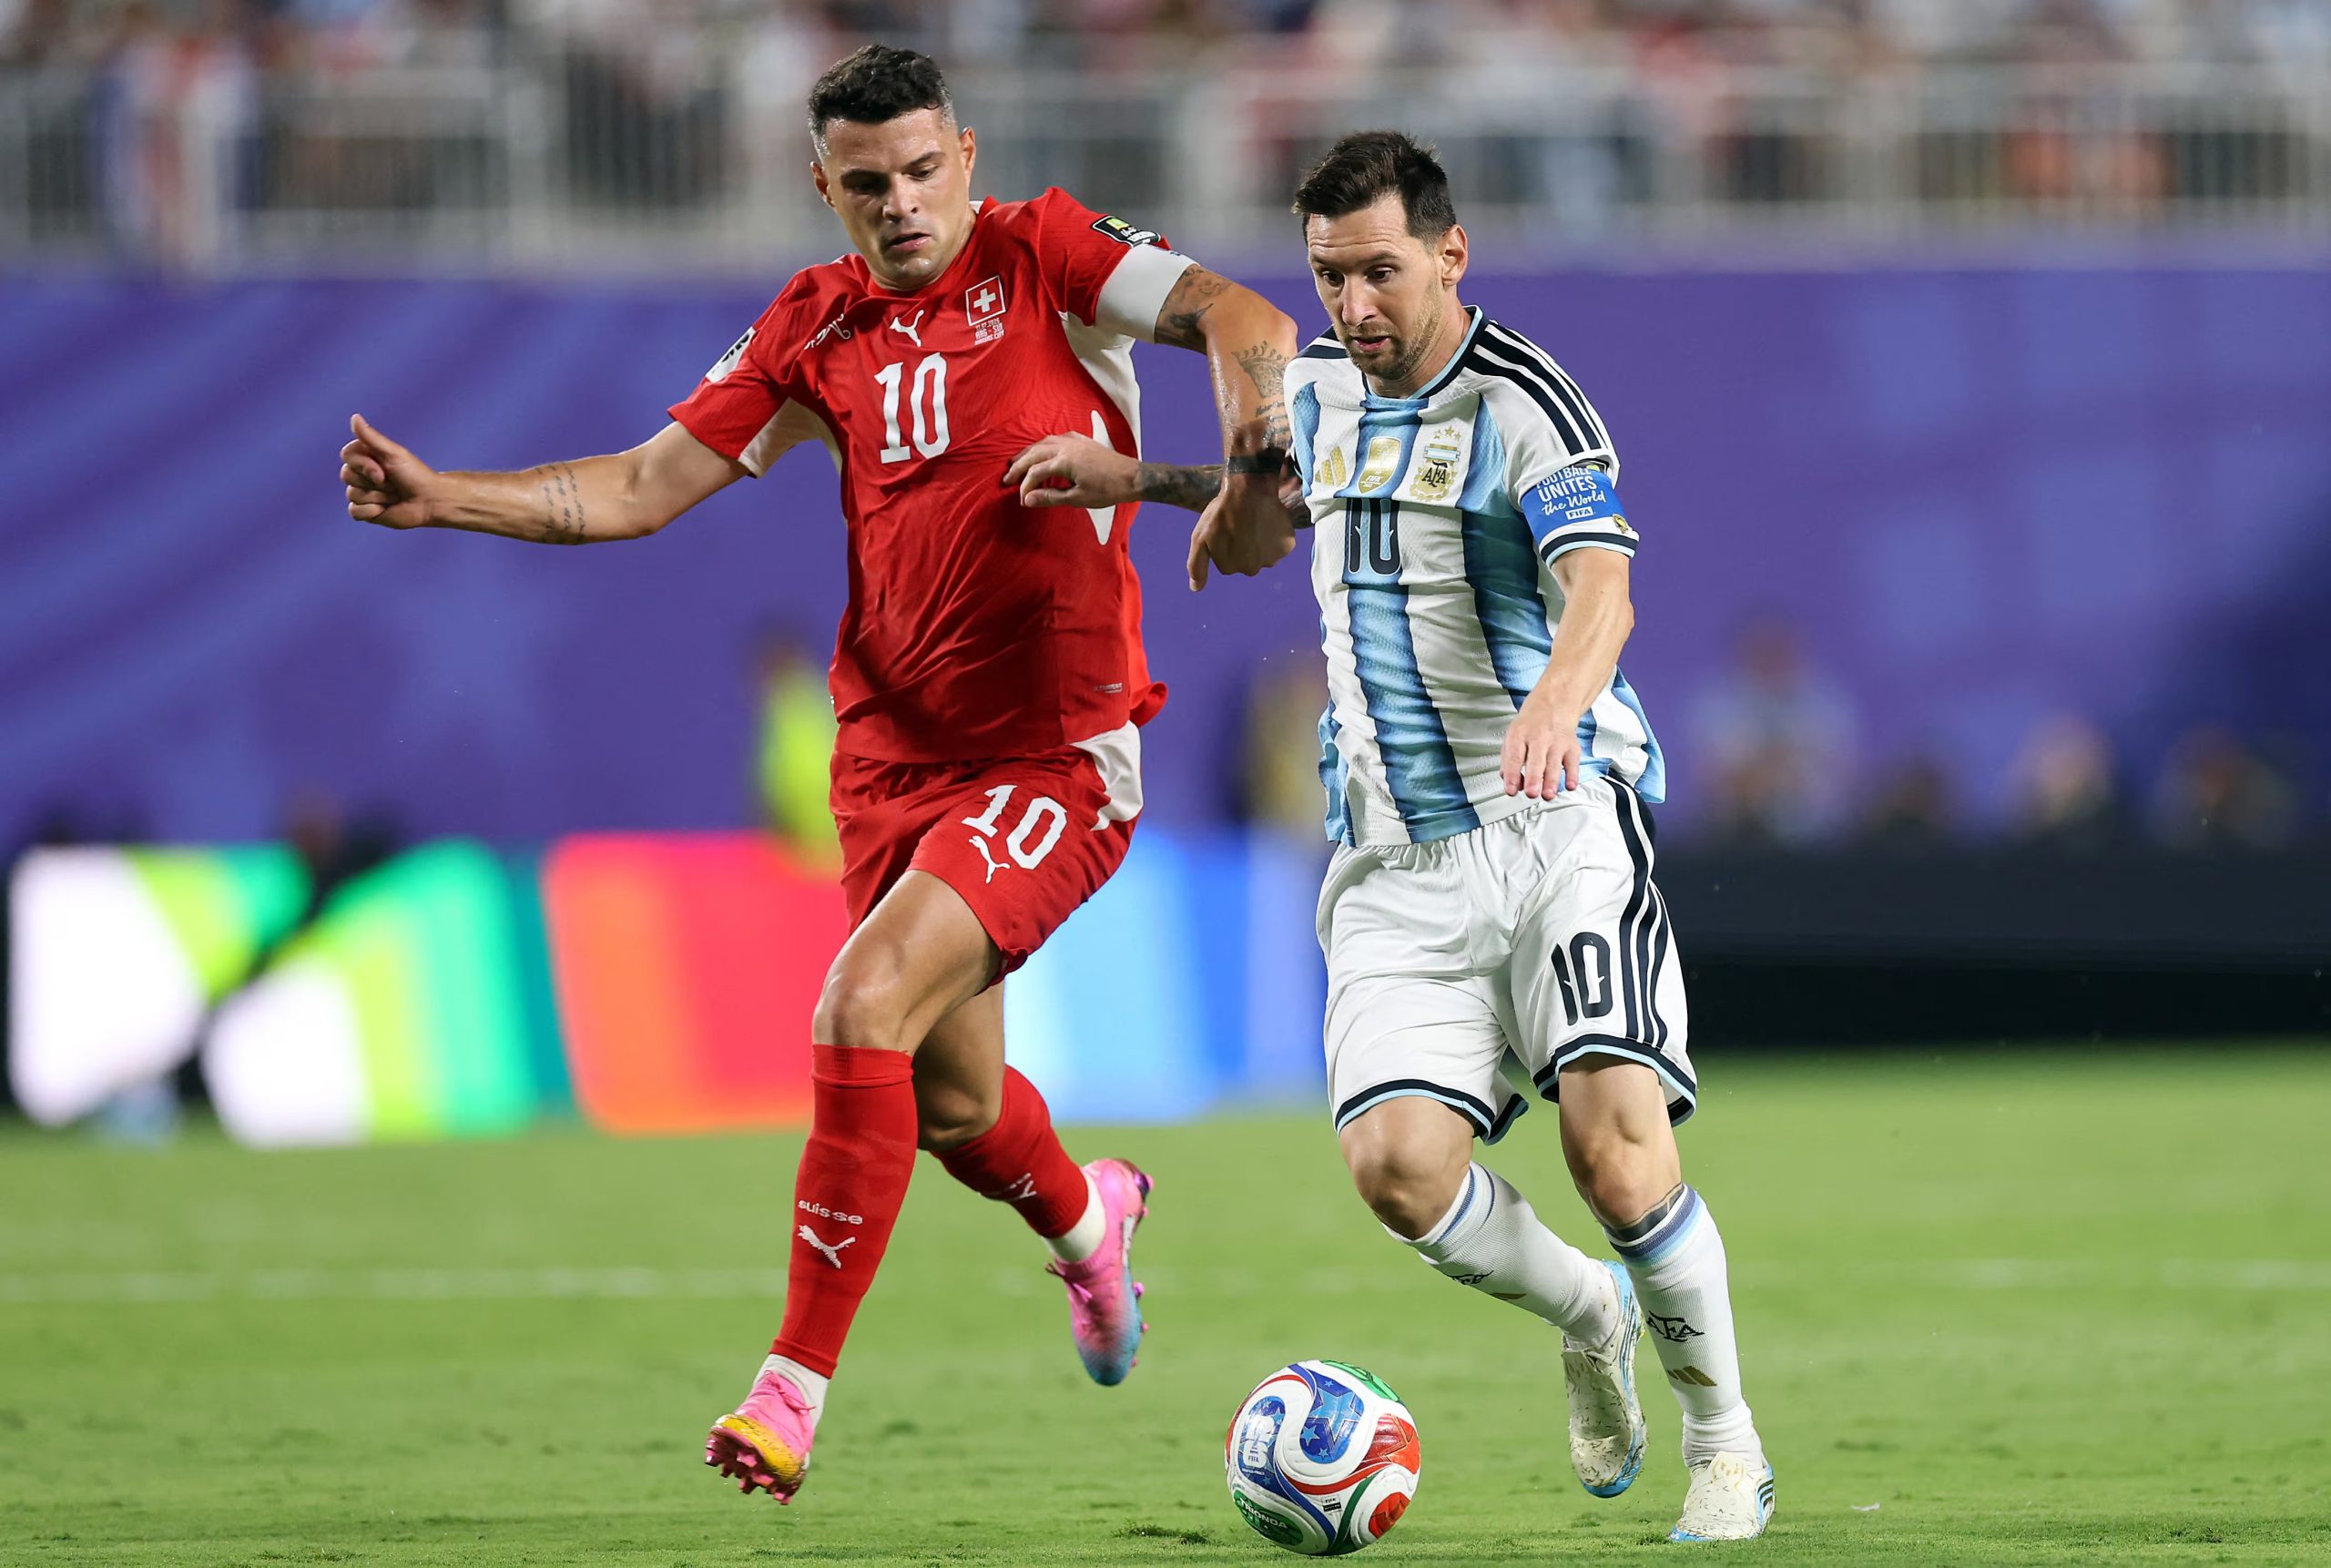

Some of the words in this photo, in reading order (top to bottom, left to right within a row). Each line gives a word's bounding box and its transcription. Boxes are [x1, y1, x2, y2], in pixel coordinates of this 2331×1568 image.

[874, 351, 951, 464] 10
[1421, 460, 1448, 487] AFA
[1538, 475, 1597, 502] UNITES
[1542, 501, 1567, 516] the
[1565, 491, 1607, 508] World
[1568, 509, 1592, 518] FIFA
[1347, 498, 1401, 575] 10
[962, 784, 1068, 871] 10
[1551, 932, 1613, 1026] 10
[799, 1199, 863, 1225] suisse
[1238, 1497, 1288, 1529] TRIONDA
